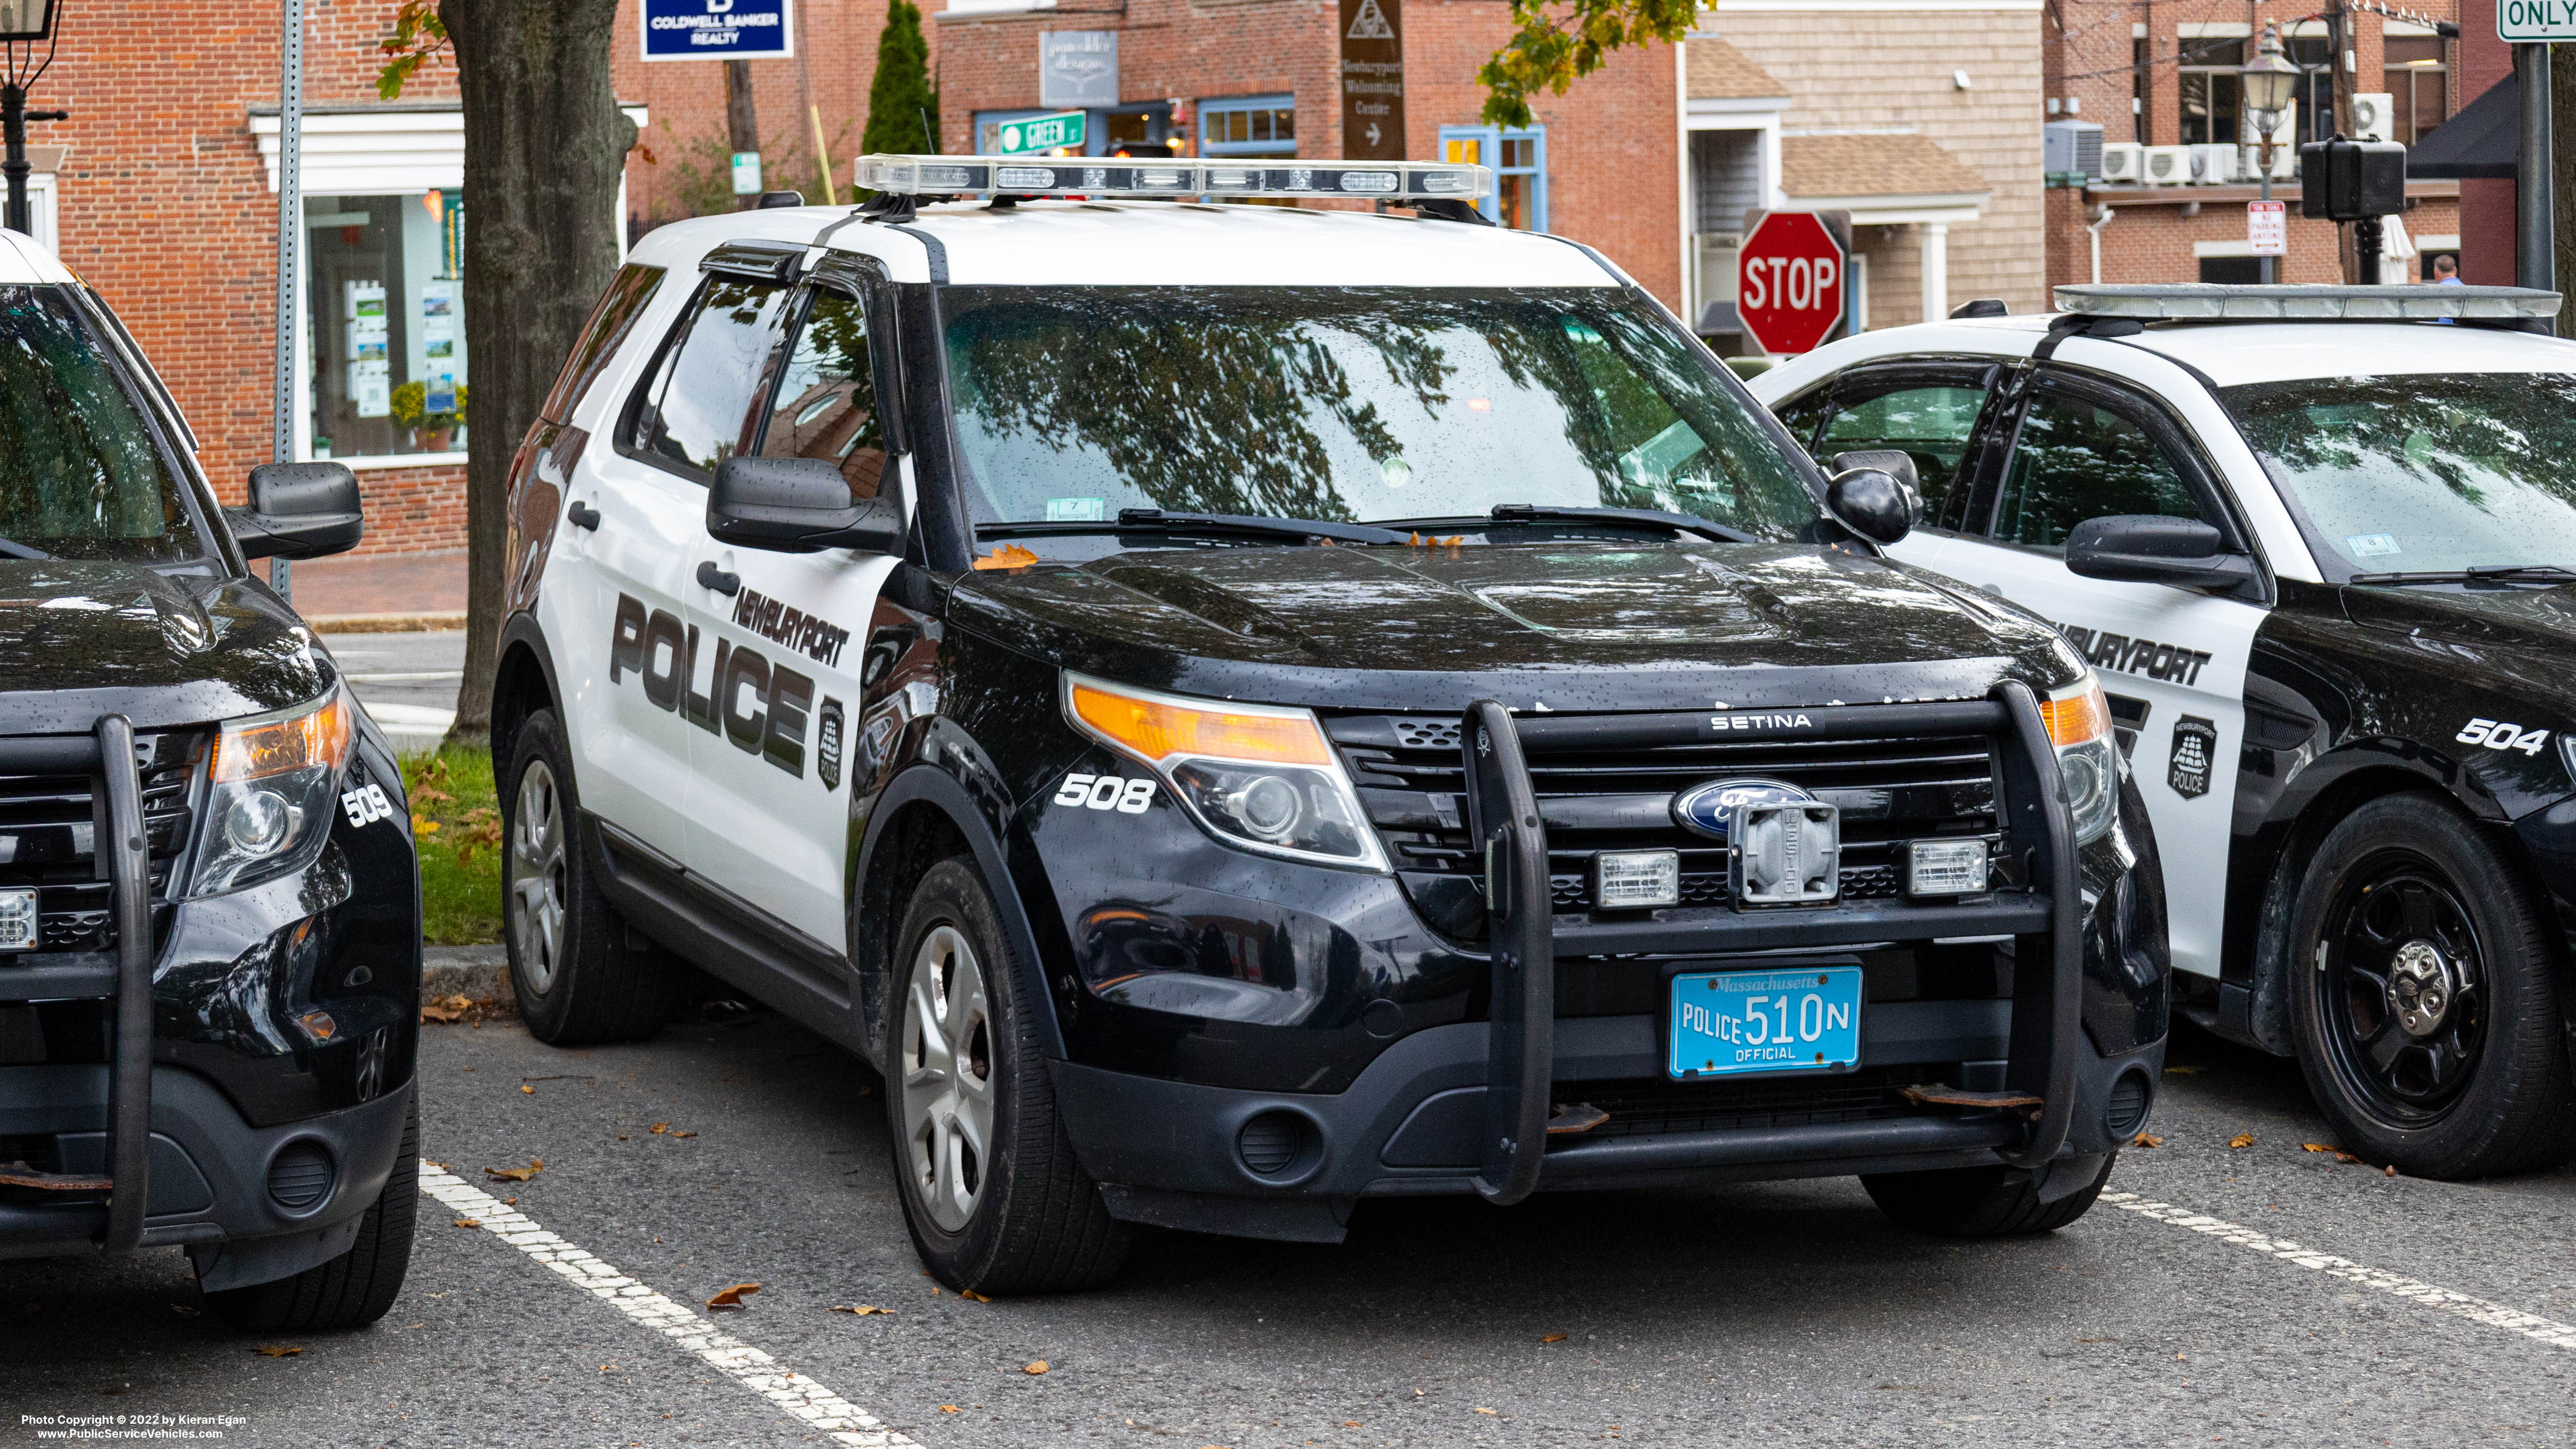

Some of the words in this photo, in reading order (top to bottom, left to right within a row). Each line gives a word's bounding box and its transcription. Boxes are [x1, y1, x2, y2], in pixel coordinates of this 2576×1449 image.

[651, 14, 723, 29] COLDWELL
[724, 13, 778, 27] BANKER
[2509, 1, 2576, 25] ONLY
[691, 31, 740, 45] REALTY
[1027, 120, 1065, 148] GREEN
[1744, 257, 1836, 310] STOP
[732, 586, 850, 668] NEWBURYPORT
[2050, 621, 2213, 686] BURYPORT
[610, 591, 815, 779] POLICE
[1711, 714, 1812, 730] SETINA
[2176, 723, 2215, 739] NEWBURYPORT
[2456, 718, 2550, 756] 504
[822, 758, 838, 783] POLICE
[2173, 771, 2203, 793] POLICE
[341, 783, 393, 828] 509
[1054, 773, 1156, 814] 508
[1715, 975, 1819, 993] Massachusetts
[1683, 1002, 1742, 1045] POLICE
[1736, 1047, 1796, 1063] OFFICIAL
